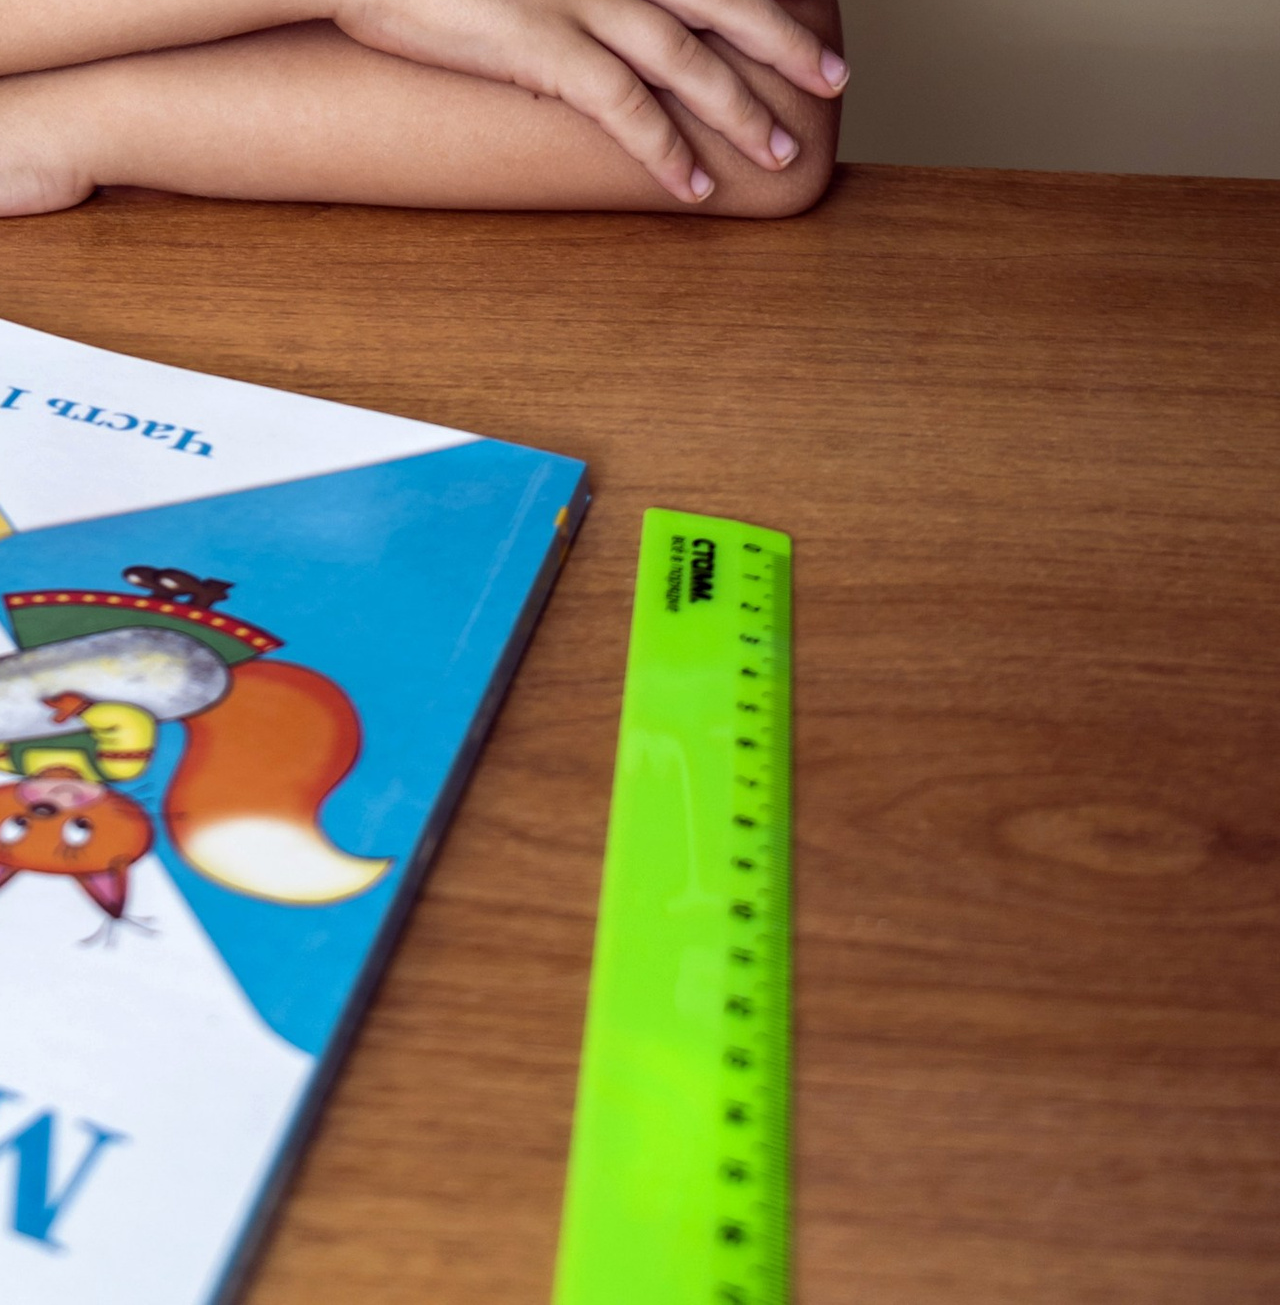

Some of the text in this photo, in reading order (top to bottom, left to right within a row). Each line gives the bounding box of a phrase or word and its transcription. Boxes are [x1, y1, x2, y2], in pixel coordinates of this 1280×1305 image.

[0, 386, 215, 459] Часть 1
[743, 542, 762, 554] 0
[742, 573, 761, 581] 1
[740, 601, 761, 613] 2
[739, 633, 761, 645] 3
